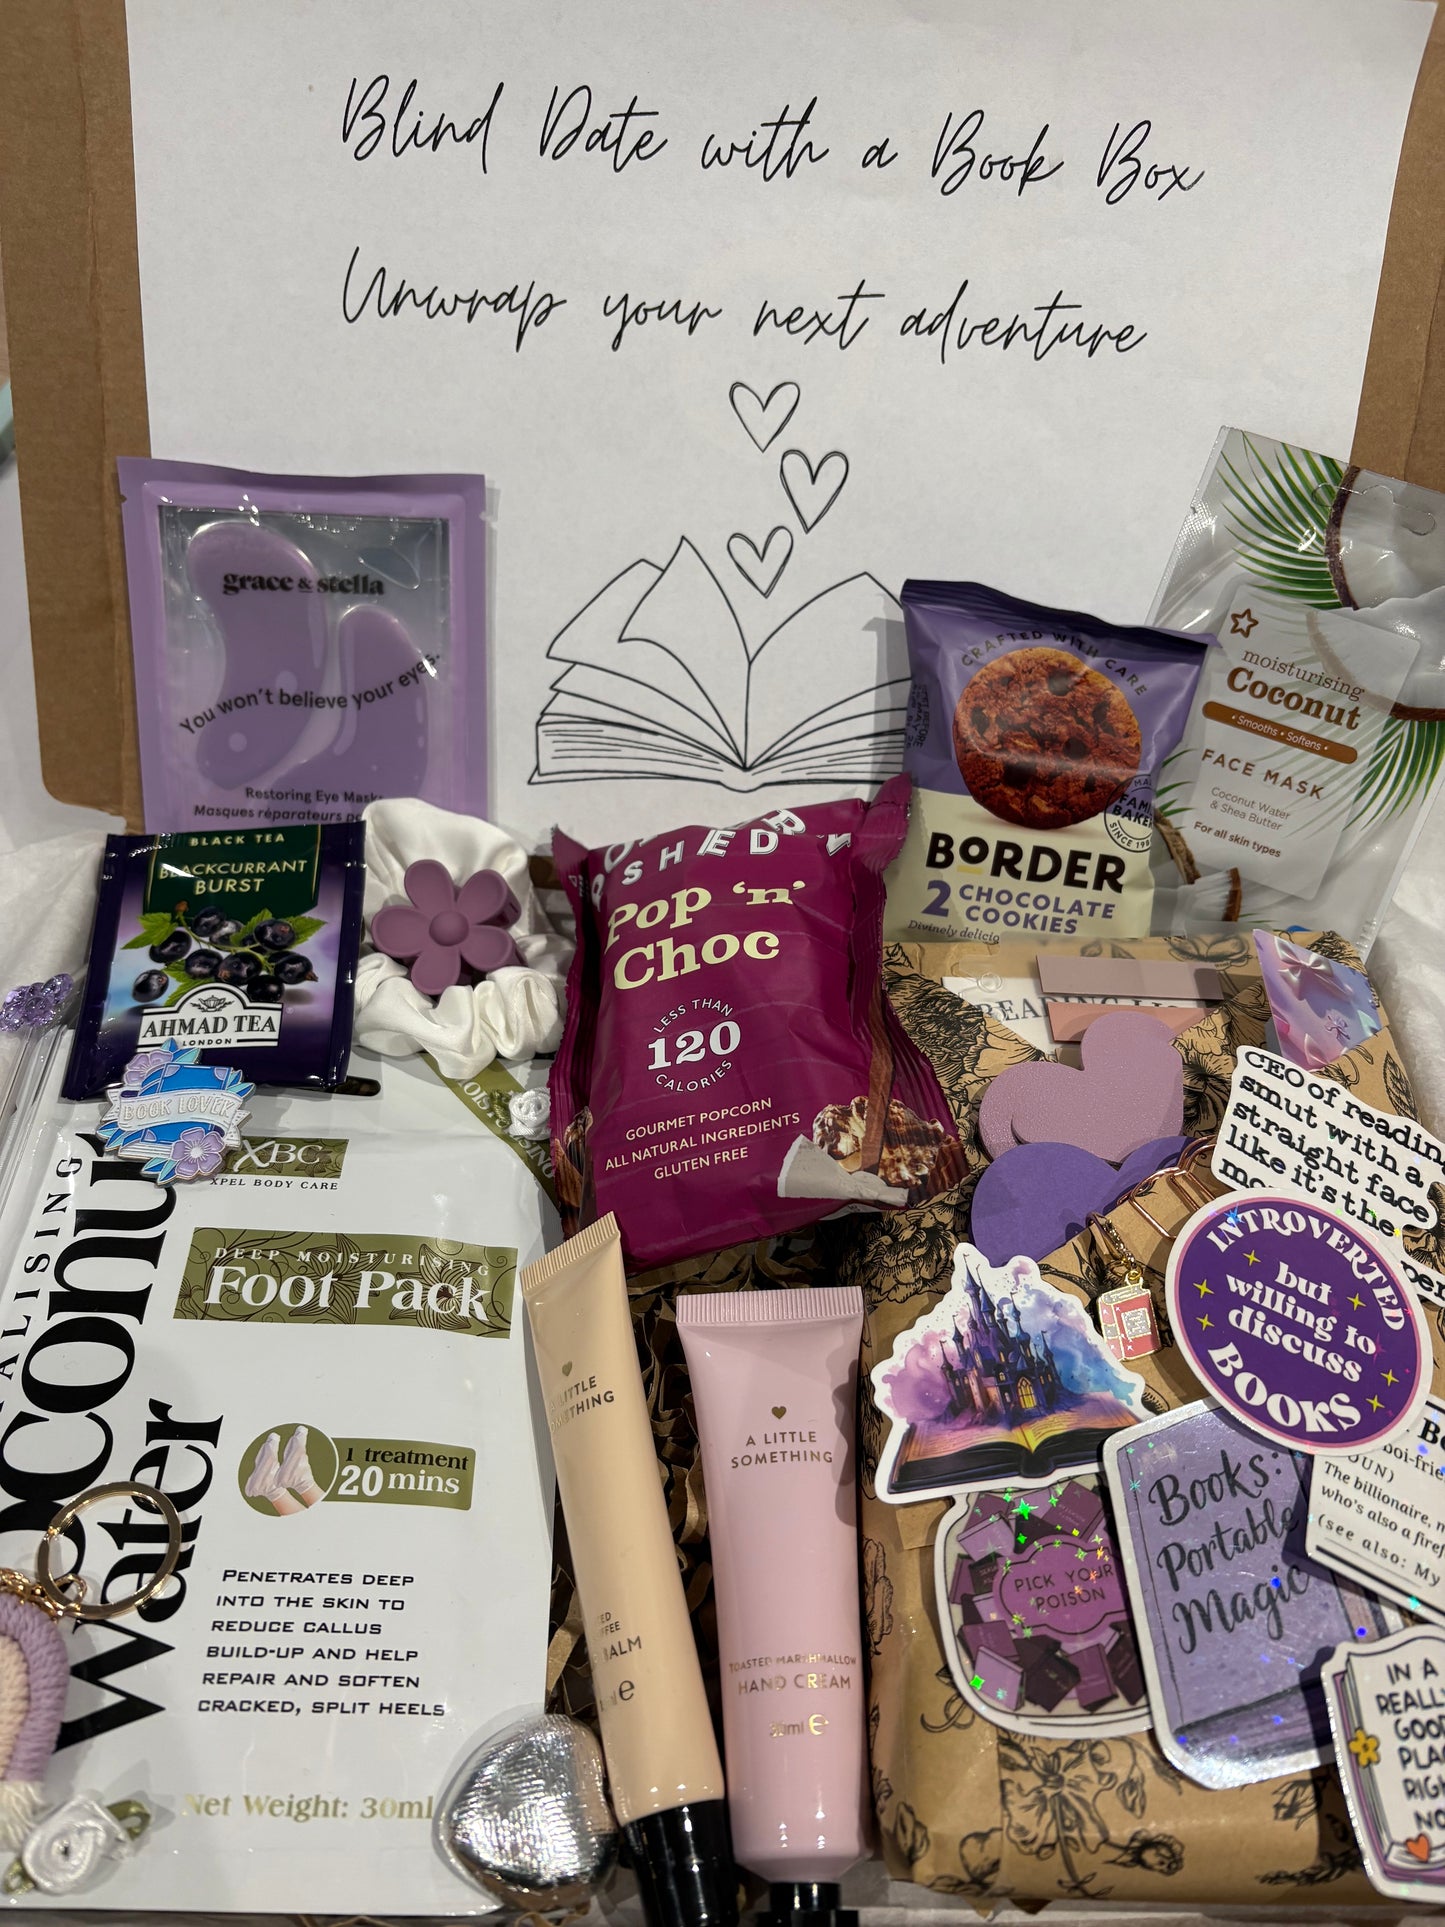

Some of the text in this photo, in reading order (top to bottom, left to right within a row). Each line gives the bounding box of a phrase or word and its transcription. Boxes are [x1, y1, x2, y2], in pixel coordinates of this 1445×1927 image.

[343, 75, 1205, 205] Blind Date with a Book Box
[343, 246, 1148, 364] Unwrap your next adventure
[222, 571, 385, 595] grace & stella
[961, 631, 1148, 698] CRAFTED WITH CARE
[1240, 648, 1366, 703] moisturising
[178, 711, 217, 737] You
[278, 688, 348, 709] believe
[352, 682, 394, 709] your
[1226, 666, 1362, 732] Coconut
[1237, 714, 1322, 753] Smooths Softens
[1201, 748, 1326, 800] FACE MASK
[246, 787, 312, 804] Restoring
[316, 790, 339, 804] Eye
[1211, 786, 1291, 821] Coconut Water
[194, 805, 343, 823] Masques réparateurs
[1209, 800, 1284, 832] & Shea Butter
[189, 833, 286, 847] BLACK TEA
[1110, 822, 1133, 847] SINCE
[1193, 820, 1282, 859] For all skin types
[622, 829, 779, 886] SHED
[926, 831, 1126, 894] BORDER
[195, 878, 265, 895] BURST
[921, 879, 1115, 920] 2 CHOCOLATE
[605, 887, 713, 954] Pop
[908, 919, 958, 938] Divinely
[965, 905, 1078, 934] COOKIES
[613, 930, 781, 991] Choc
[142, 1014, 277, 1038] AHMAD TEA
[653, 998, 735, 1035] LESS THAN
[181, 1038, 232, 1047] LONDON
[647, 1020, 742, 1071] 120
[655, 1059, 733, 1092] CALORIES
[1244, 1050, 1305, 1088] CEO
[1308, 1083, 1340, 1108] of
[122, 1095, 237, 1121] BOOK LOVER
[625, 1097, 773, 1142] GOURMET POPCORN
[604, 1112, 801, 1172] ALL NATURAL INGREDIENTS
[1239, 1074, 1424, 1188] smut with a
[234, 1140, 324, 1173] XBC
[653, 1146, 749, 1181] GLUTEN FREE
[1232, 1101, 1431, 1223] straight face
[210, 1177, 339, 1191] XPEL BODY CARE
[1225, 1124, 1287, 1175] like
[1341, 1191, 1396, 1238] the
[214, 1247, 490, 1277] DEEP MOISTURISING
[1206, 1207, 1406, 1331] INTROVERTED
[203, 1266, 492, 1323] Foot Pack
[1274, 1261, 1333, 1306] but
[1226, 1273, 1377, 1356] willing to
[1228, 1305, 1362, 1384] discuss
[1208, 1341, 1362, 1433] BOOKS
[745, 1430, 817, 1447] A LITTLE
[364, 1447, 470, 1471] treatment
[731, 1450, 833, 1469] SOMETHING
[338, 1464, 461, 1497] 20 mins
[1148, 1450, 1282, 1526] Books:
[1324, 1461, 1351, 1484] The
[1353, 1476, 1432, 1528] billionaire,
[1321, 1485, 1364, 1515] who's
[1367, 1508, 1398, 1532] also
[1402, 1527, 1411, 1540] a
[1157, 1499, 1300, 1592] Portable
[1318, 1513, 1441, 1588] (see also: My
[51, 1397, 224, 1754] Water
[222, 1569, 415, 1587] PENETRATES DEEP
[1014, 1573, 1056, 1593] PICK
[1065, 1563, 1114, 1582] YOUR
[216, 1595, 405, 1611] INTO THE SKIN TO
[1034, 1587, 1107, 1610] POISON
[1172, 1565, 1310, 1654] Magic
[211, 1620, 382, 1635] REDUCE CALLUS
[206, 1646, 418, 1662] BUILD-UP AND HELP
[729, 1656, 772, 1674] TOASTED
[1386, 1657, 1439, 1686] IN A
[202, 1673, 420, 1689] REPAIR AND SOFTEN
[738, 1672, 851, 1695] HAND CREAM
[198, 1700, 446, 1716] CRACKED, SPLIT HEELS
[1397, 1745, 1445, 1770] PLA
[184, 1793, 434, 1823] Net Weight: 30ml
